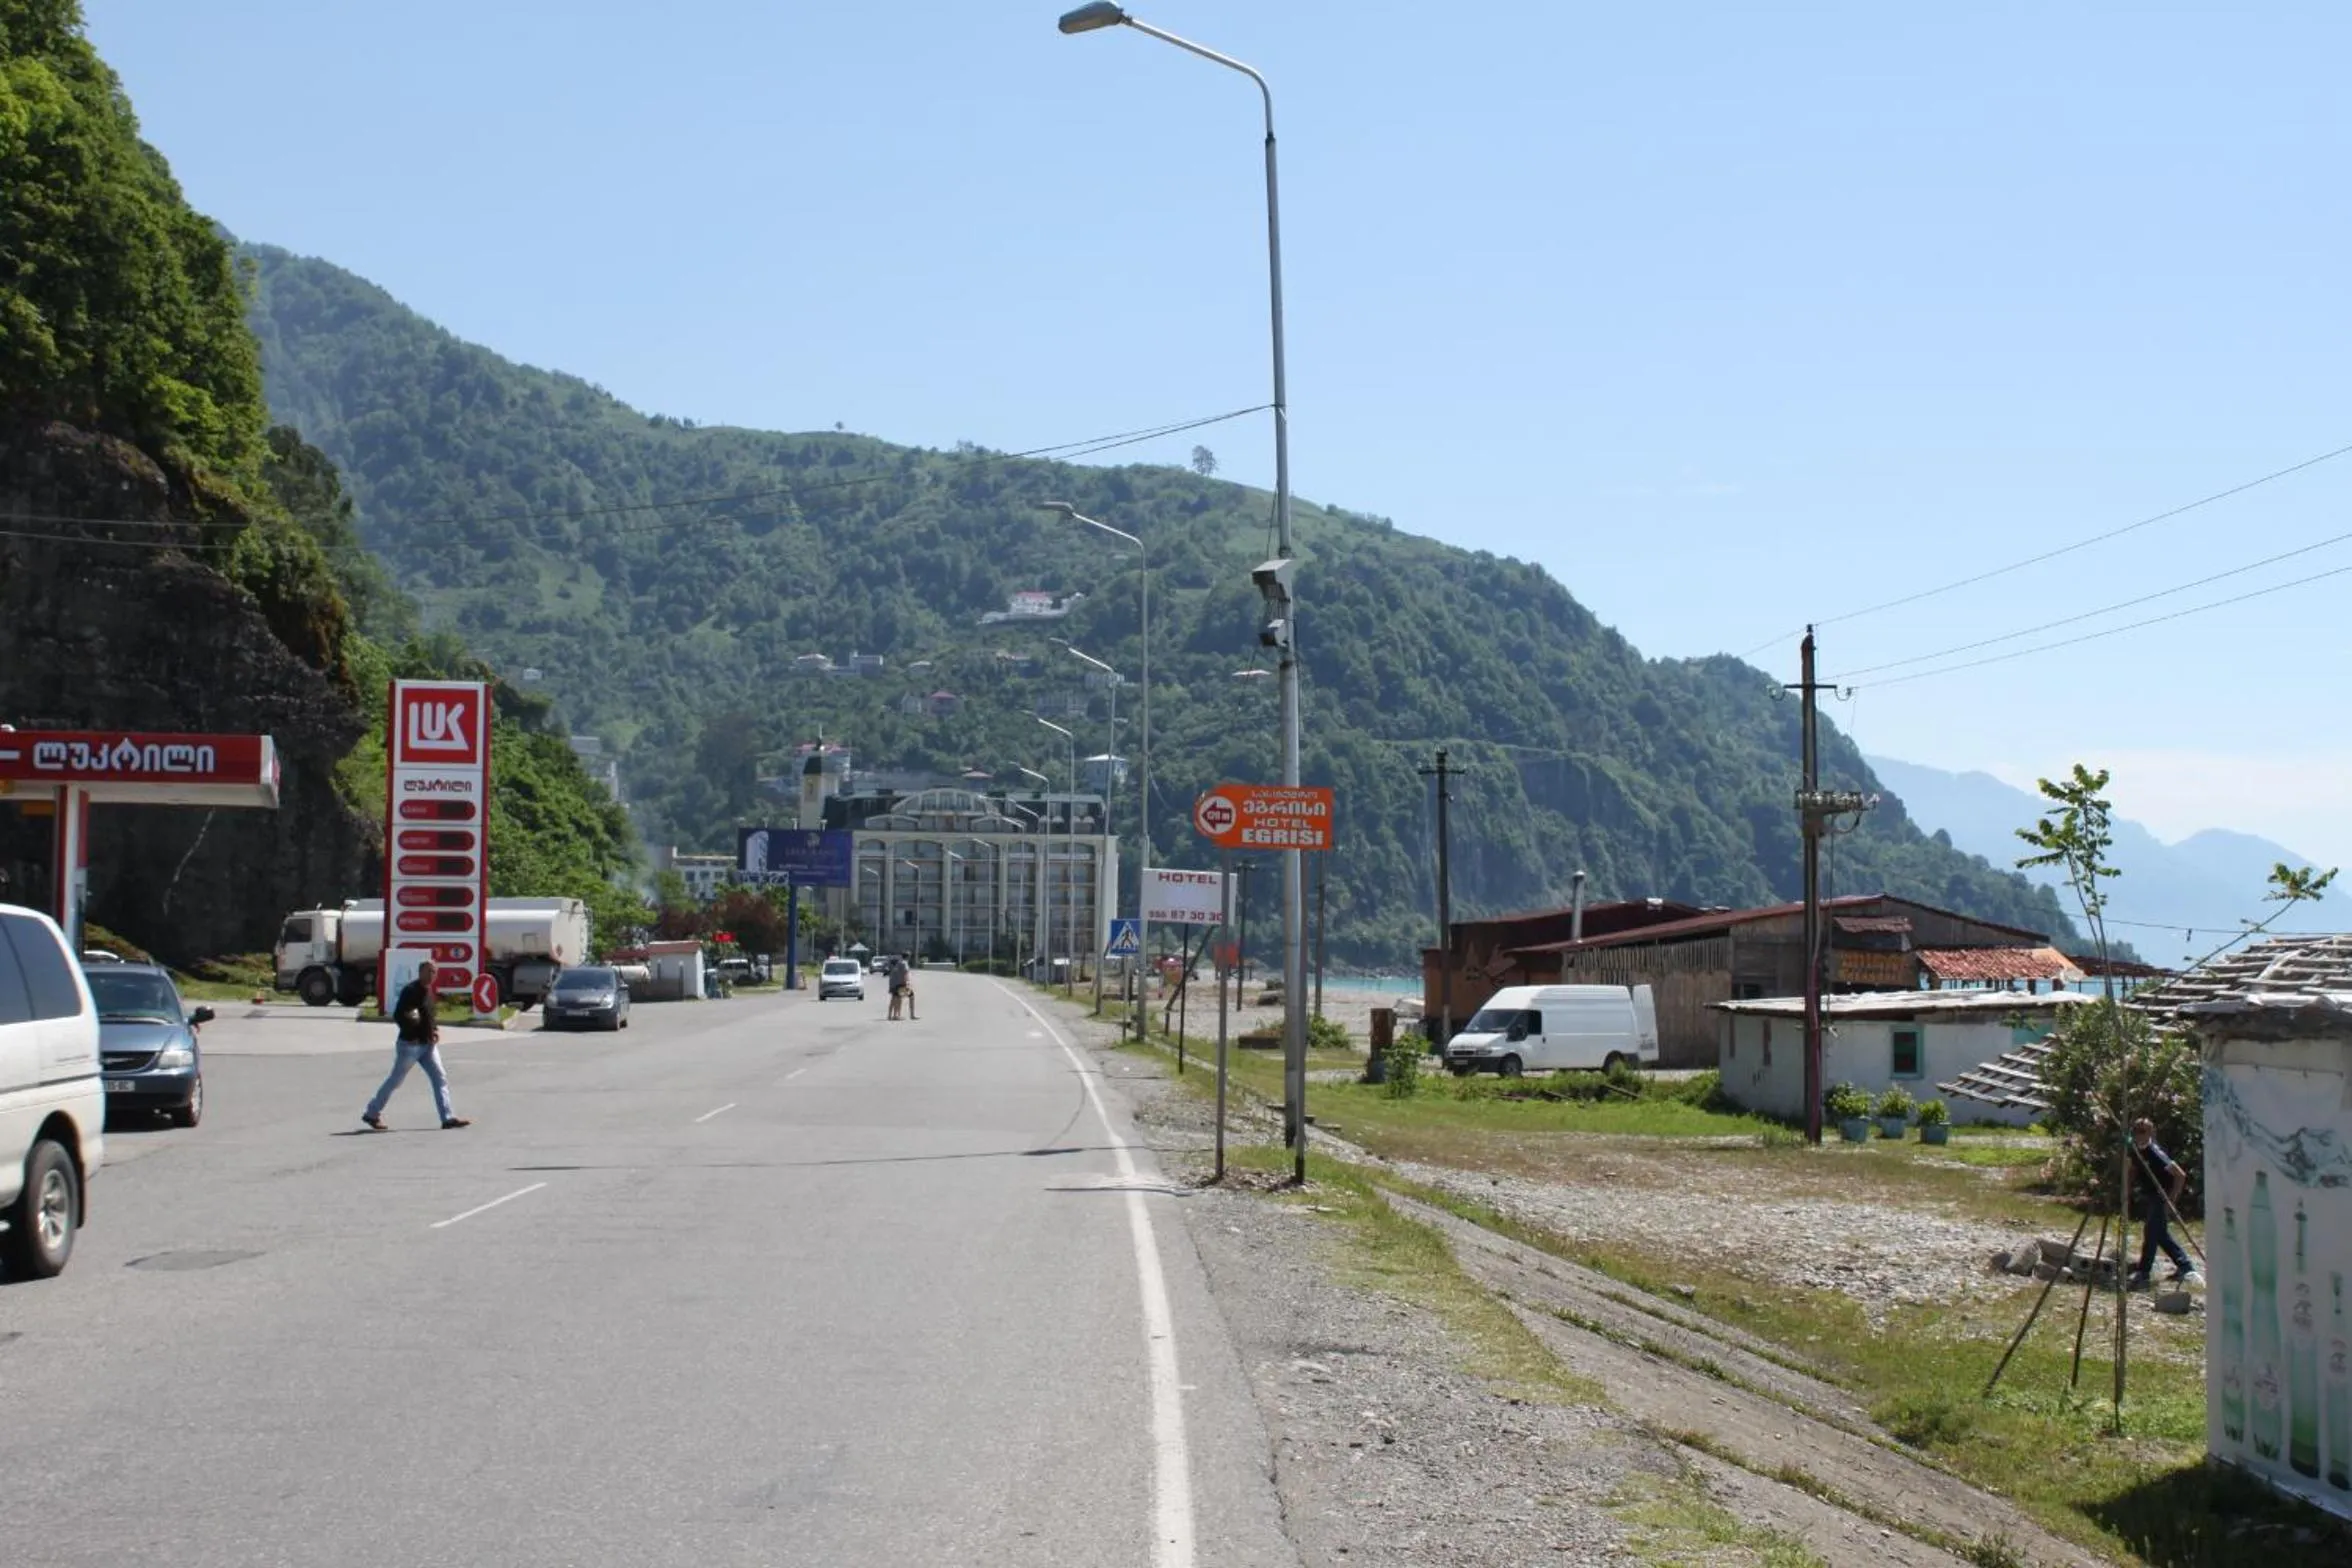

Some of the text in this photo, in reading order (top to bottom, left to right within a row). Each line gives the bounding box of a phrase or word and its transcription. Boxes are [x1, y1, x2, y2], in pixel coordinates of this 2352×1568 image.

[408, 702, 470, 751] LUK
[1253, 817, 1312, 829] HOTEL
[1242, 828, 1325, 845] EGRISI
[1158, 871, 1217, 885] HOTEL
